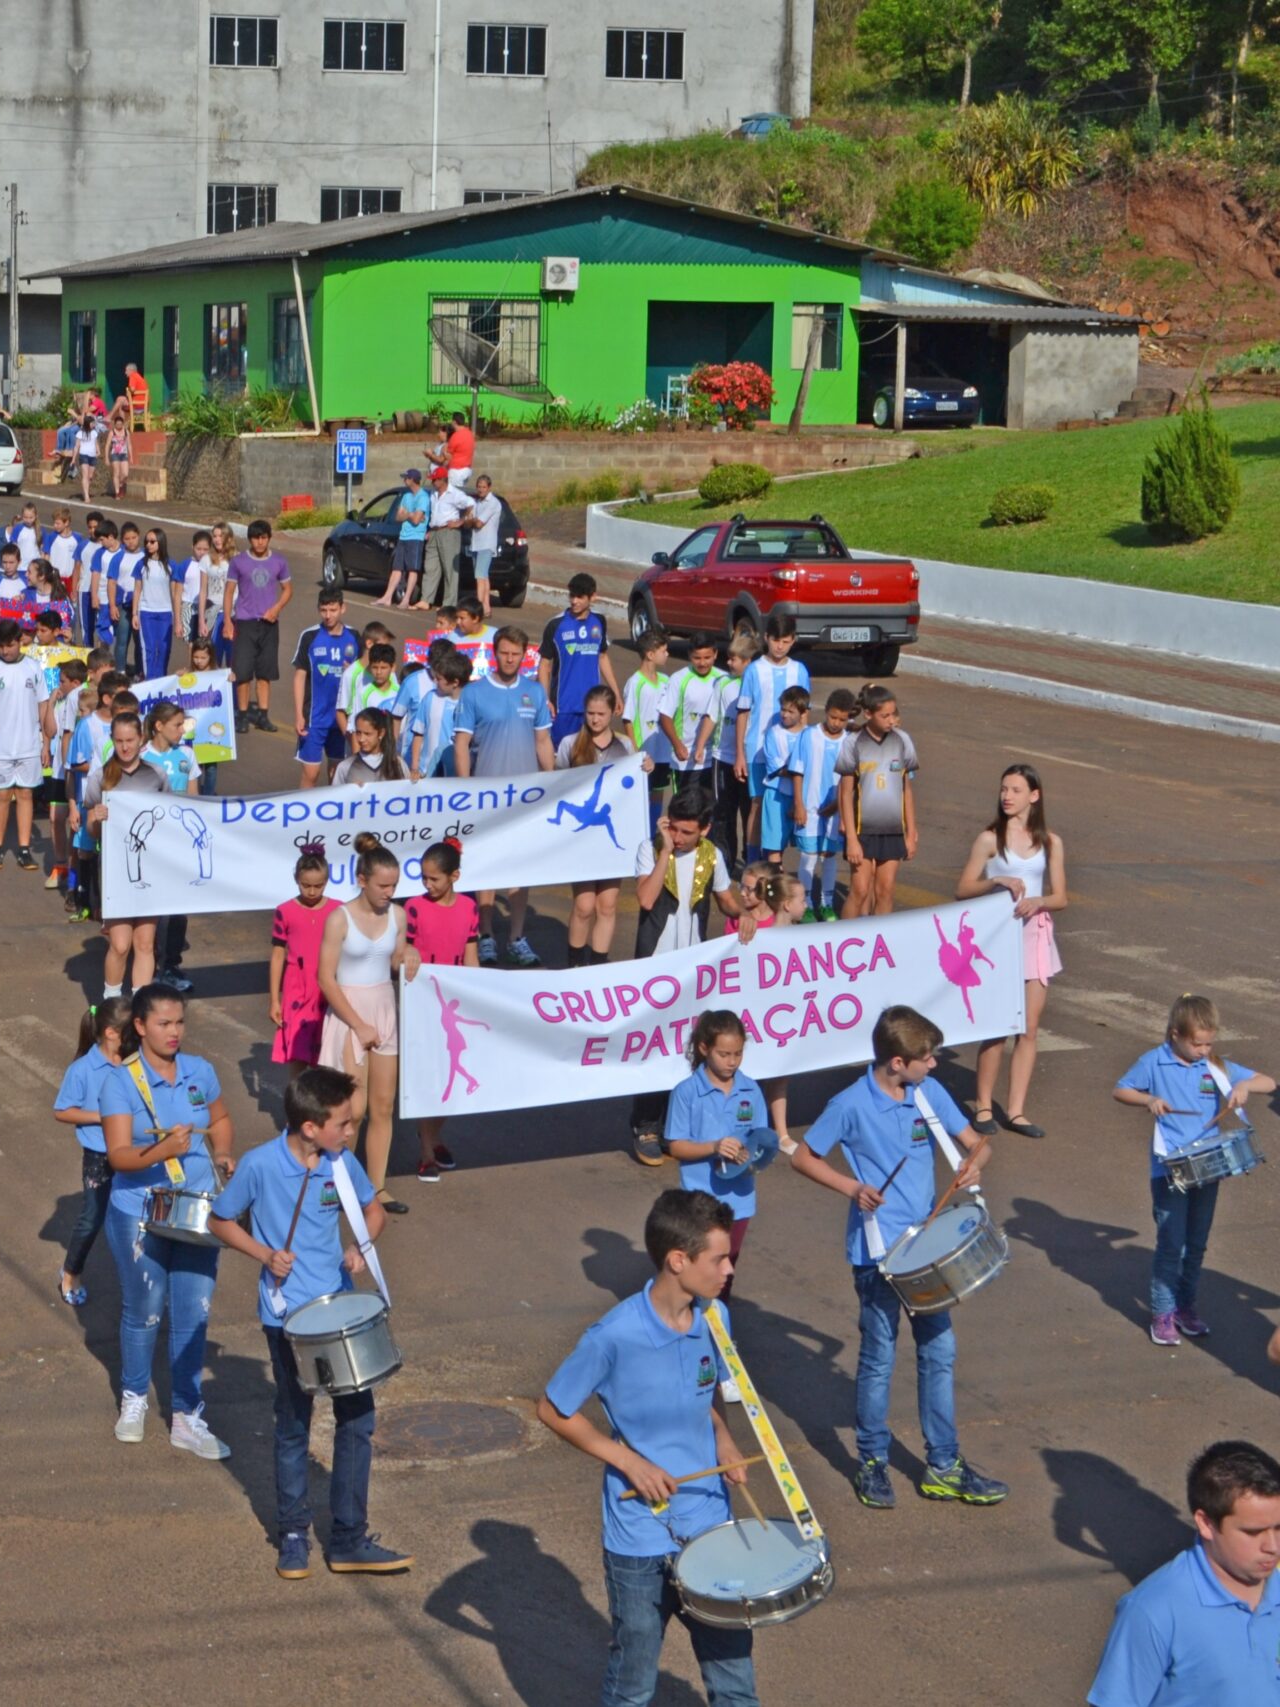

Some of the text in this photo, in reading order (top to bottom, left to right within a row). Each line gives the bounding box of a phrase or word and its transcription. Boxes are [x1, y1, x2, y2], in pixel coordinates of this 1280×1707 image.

[339, 432, 365, 440] ACESSO
[341, 443, 362, 456] km
[343, 456, 358, 471] 11
[832, 588, 879, 597] WORKING
[579, 625, 588, 639] 6
[330, 647, 341, 661] 14
[163, 760, 175, 774] 2
[875, 773, 886, 790] 6
[221, 781, 546, 829] Departamento
[293, 830, 326, 849] de
[443, 820, 475, 841] de
[532, 932, 897, 1024] GRUPO DE DANÇA
[580, 991, 864, 1066] E PATAÇÃO
